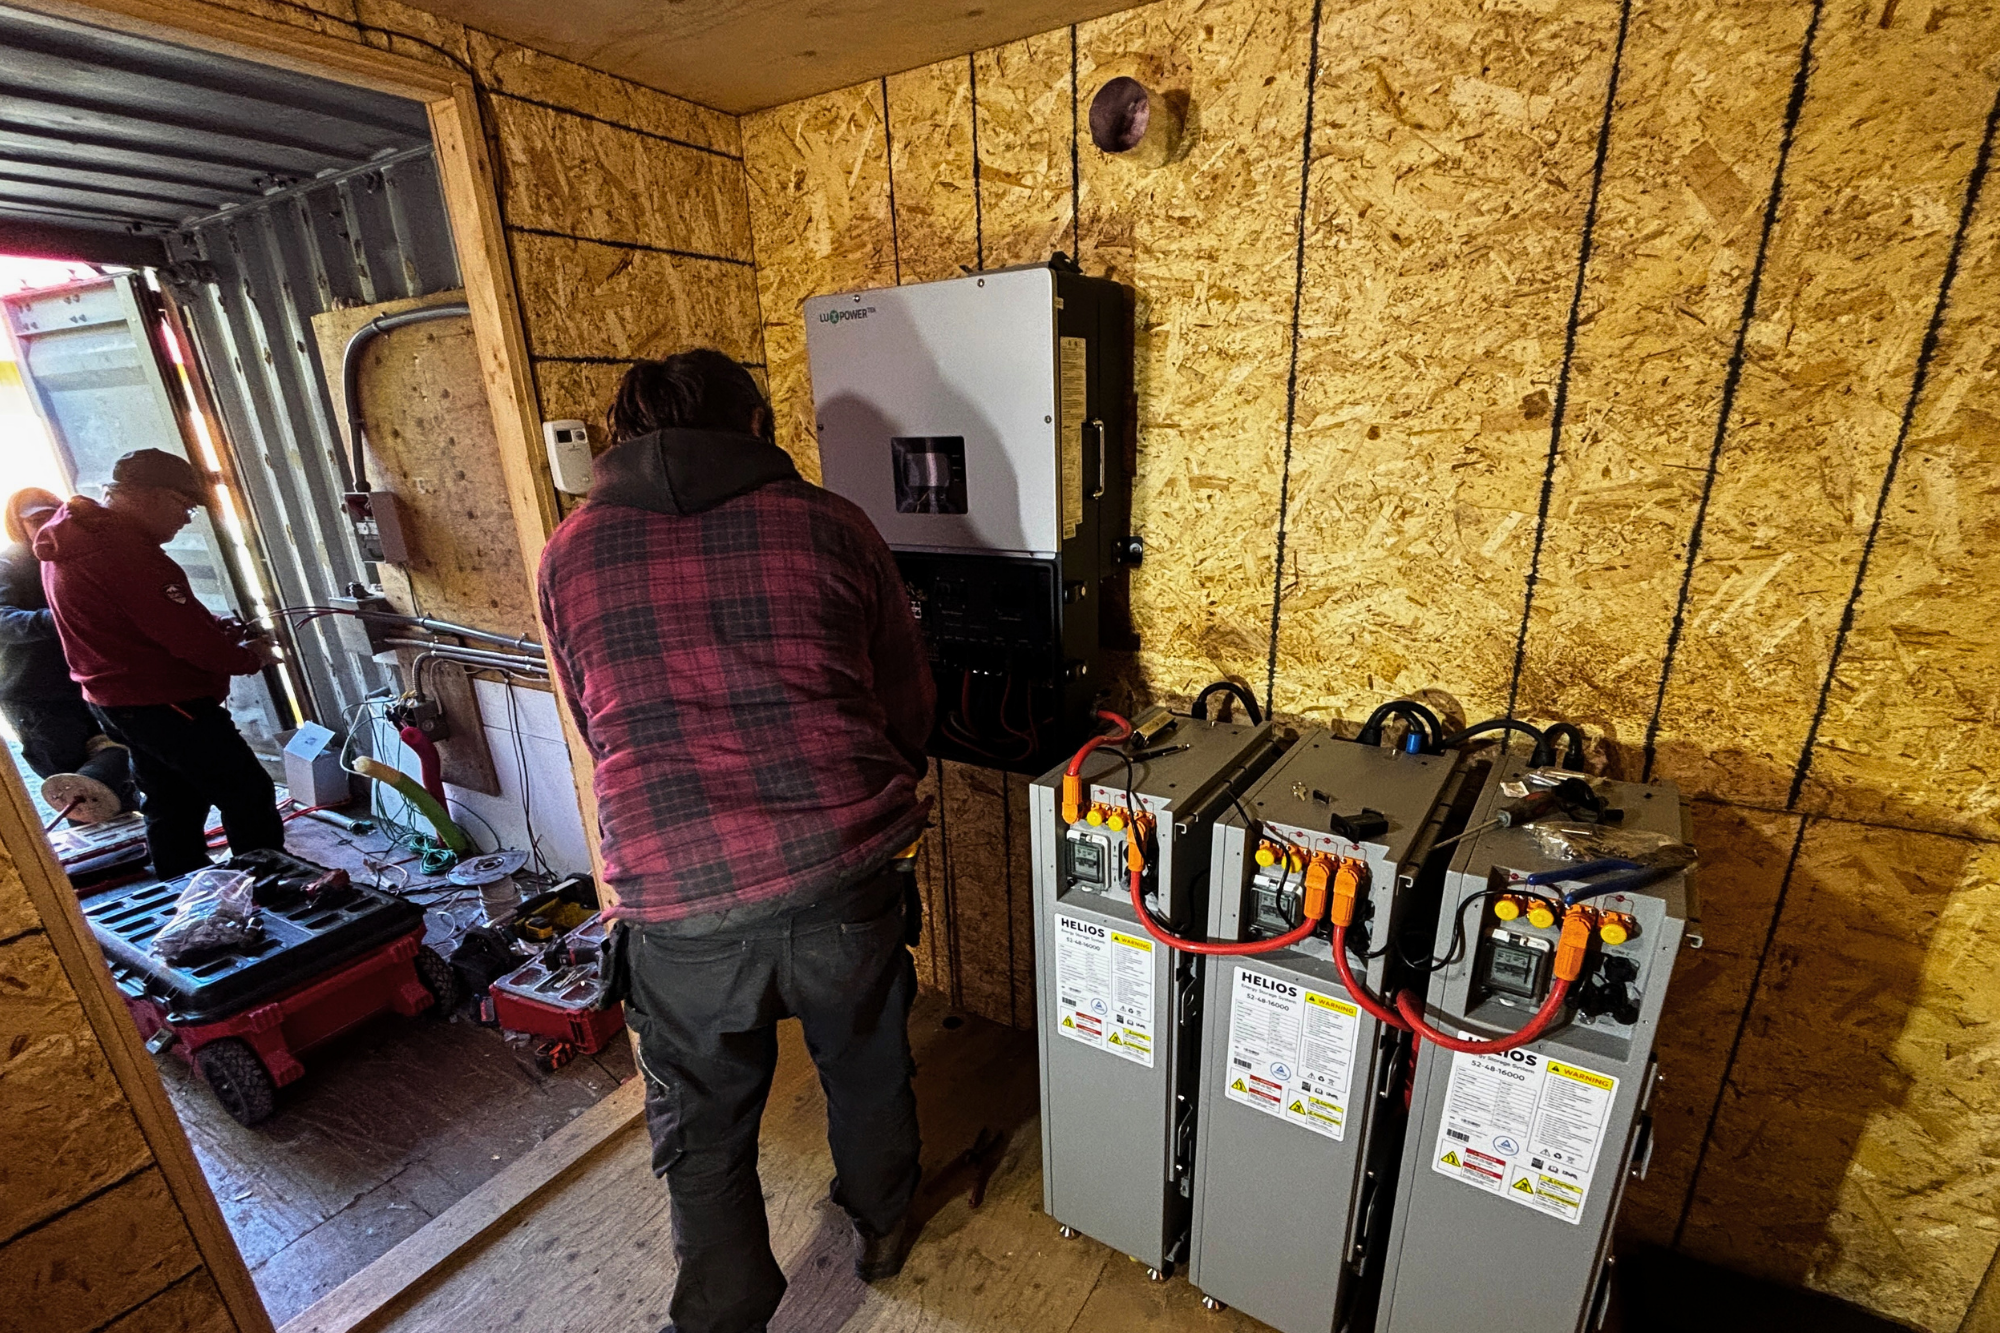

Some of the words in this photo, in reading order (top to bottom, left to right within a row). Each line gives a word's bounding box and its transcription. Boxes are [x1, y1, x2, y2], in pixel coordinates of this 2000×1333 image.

[1061, 917, 1105, 938] HELIOS
[1121, 938, 1150, 950] WARNING
[1241, 971, 1297, 998] HELIOS
[1241, 983, 1258, 993] Energy
[1259, 988, 1278, 999] Storage
[1278, 994, 1297, 1004] System
[1246, 993, 1289, 1011] 52-48-16000
[1318, 999, 1354, 1014] WARNING
[1471, 1060, 1525, 1081] 52-48-16000
[1487, 1055, 1511, 1067] Storage
[1512, 1063, 1535, 1074] System
[1563, 1068, 1609, 1087] WARNING
